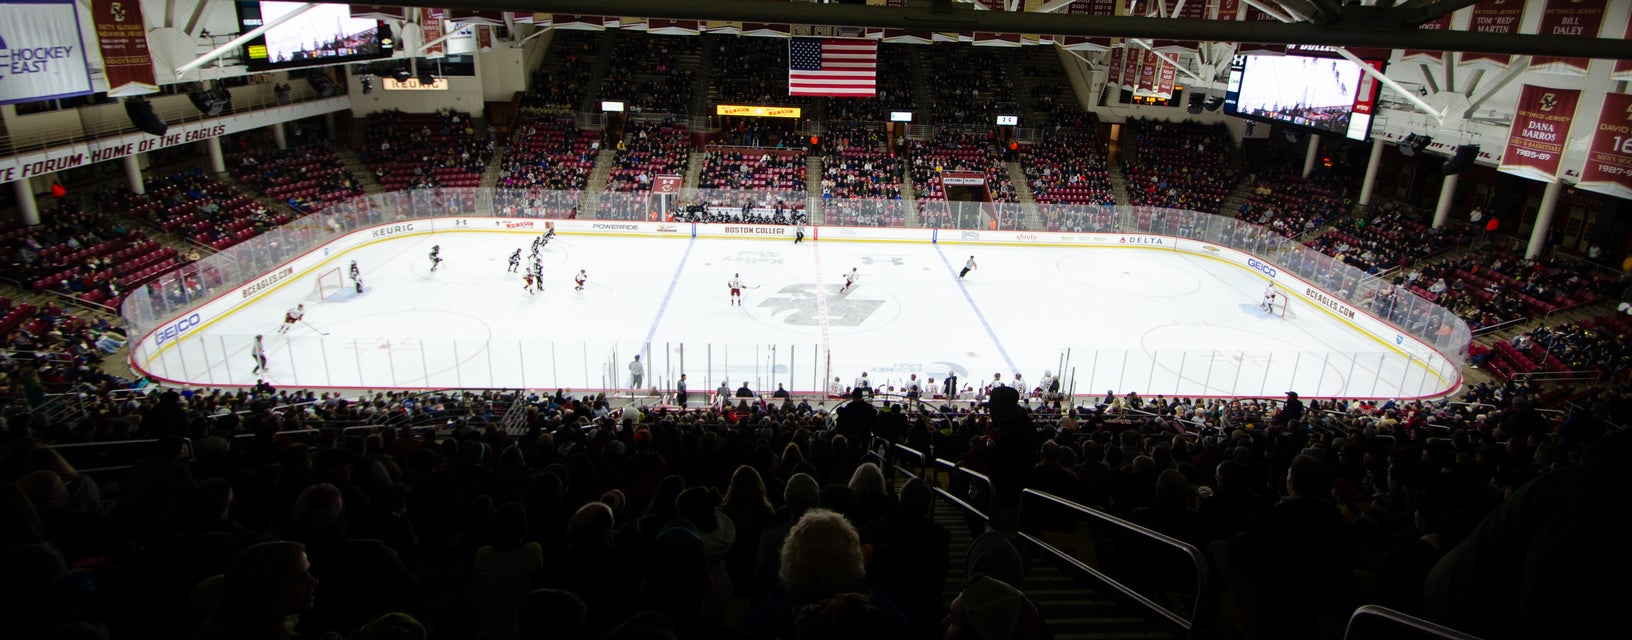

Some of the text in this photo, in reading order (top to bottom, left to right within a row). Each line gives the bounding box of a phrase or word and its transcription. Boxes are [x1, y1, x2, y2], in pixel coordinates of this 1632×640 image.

[1477, 16, 1493, 24] TOM
[1561, 16, 1580, 25] BILL
[1477, 25, 1510, 33] MARTIN
[1552, 26, 1584, 35] DALEY
[11, 46, 73, 61] HOCKEY
[11, 60, 48, 74] EAST
[1545, 114, 1571, 123] JERSEY
[1528, 120, 1554, 132] DANA
[1599, 123, 1629, 134] DAVID
[1521, 128, 1556, 142] BARROS
[1511, 137, 1562, 152] MEN'S BASKETBALL
[22, 153, 83, 178] FORUM
[92, 143, 134, 164] HOME
[138, 138, 156, 152] OF
[161, 132, 181, 147] THE
[186, 124, 226, 142] EAGLES
[1516, 148, 1550, 161] 1985-89
[1596, 154, 1617, 164] MEN'S
[372, 223, 415, 238] KEURIG
[592, 223, 639, 231] POWERADE
[724, 225, 785, 235] BOSTON COLLEGE
[1129, 236, 1163, 245] DELTA
[1247, 257, 1277, 278] GEICO
[241, 265, 294, 299] BCEAGLES.COM
[1305, 287, 1356, 320] BCEAGLES.COM
[155, 312, 201, 346] GEICO
